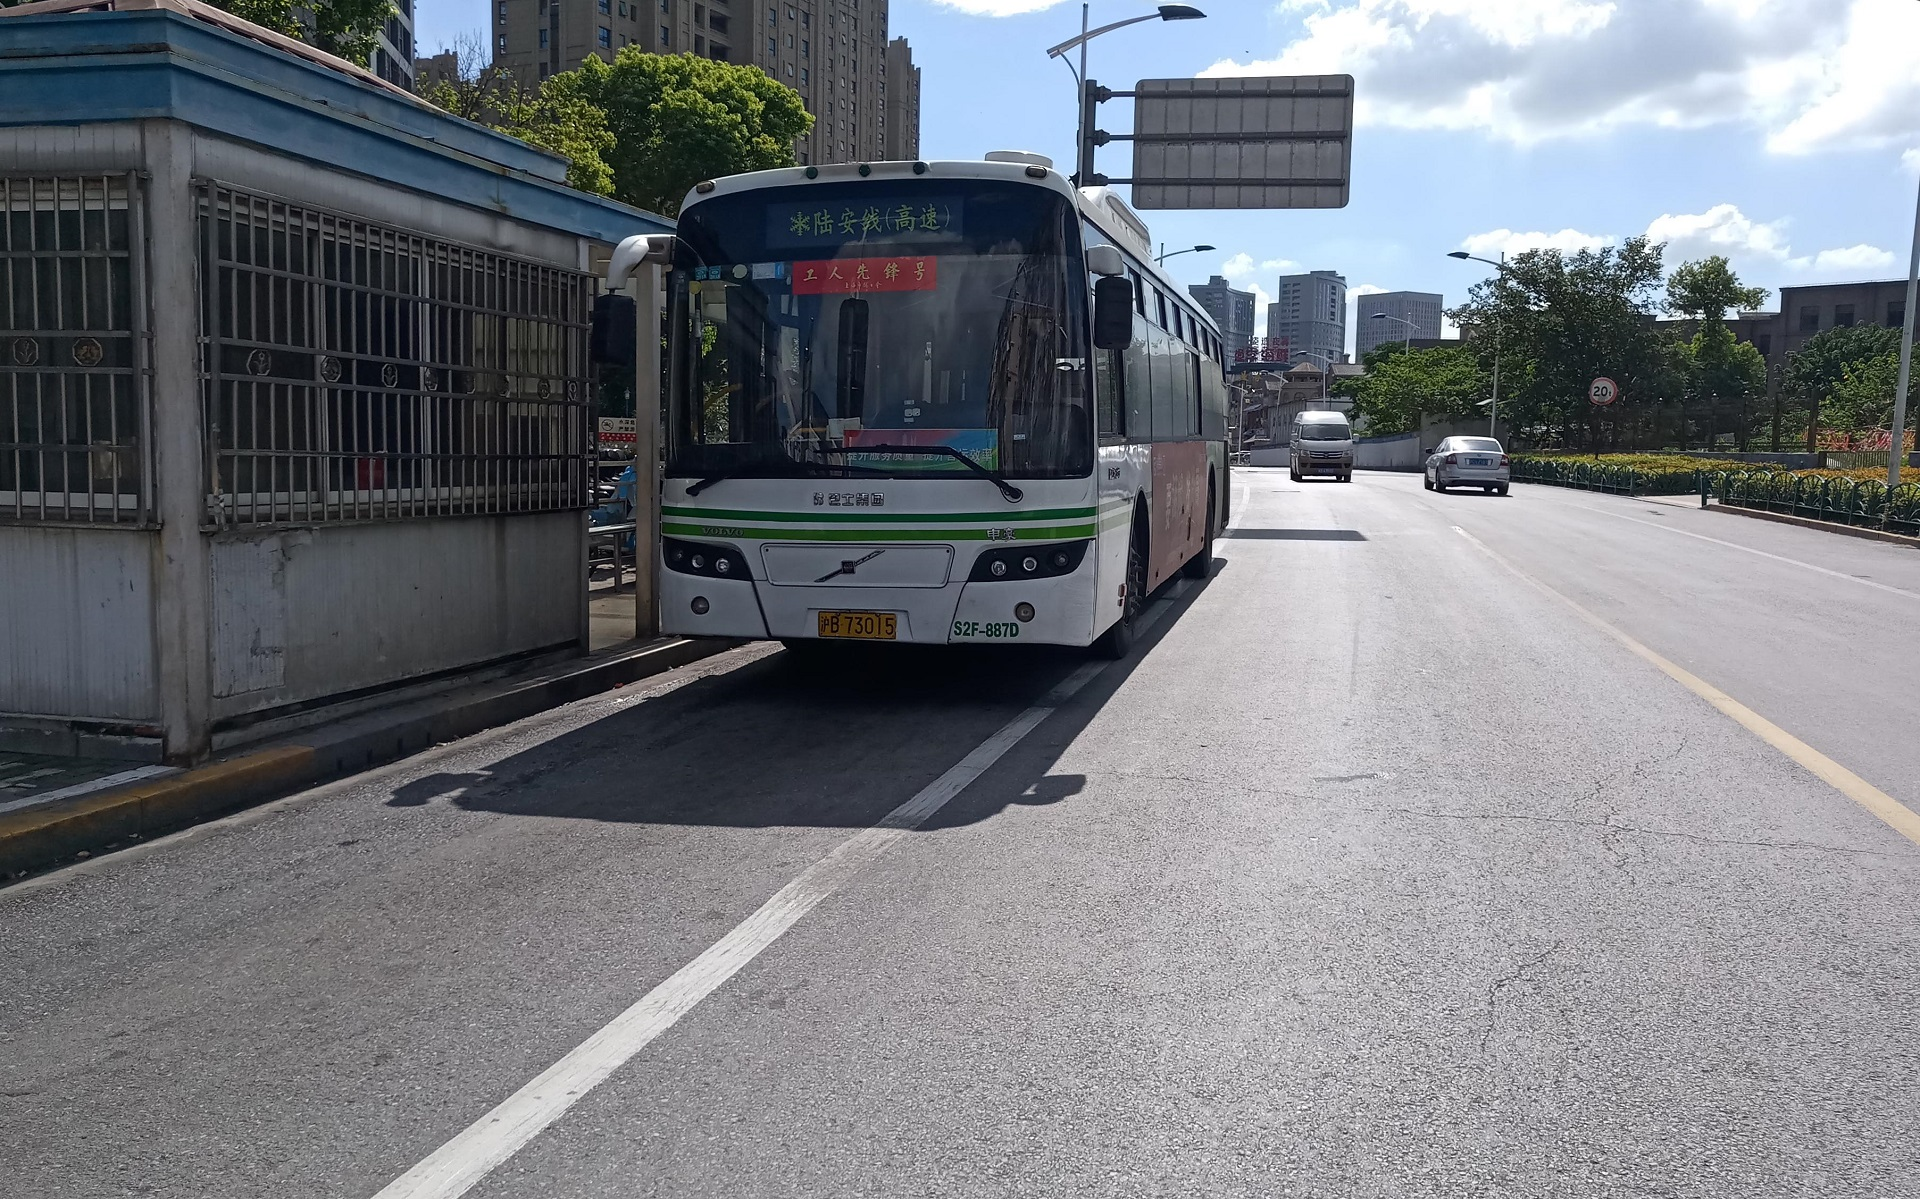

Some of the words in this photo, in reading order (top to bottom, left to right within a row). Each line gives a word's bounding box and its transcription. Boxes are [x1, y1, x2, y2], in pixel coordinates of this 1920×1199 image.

[814, 203, 950, 237] 陆安线(高速)
[803, 260, 926, 282] 工人先锋号
[1593, 386, 1611, 396] 20t
[828, 492, 885, 506] 巴士集团
[702, 527, 744, 536] VOLVO
[953, 620, 1020, 638] S2F-887D
